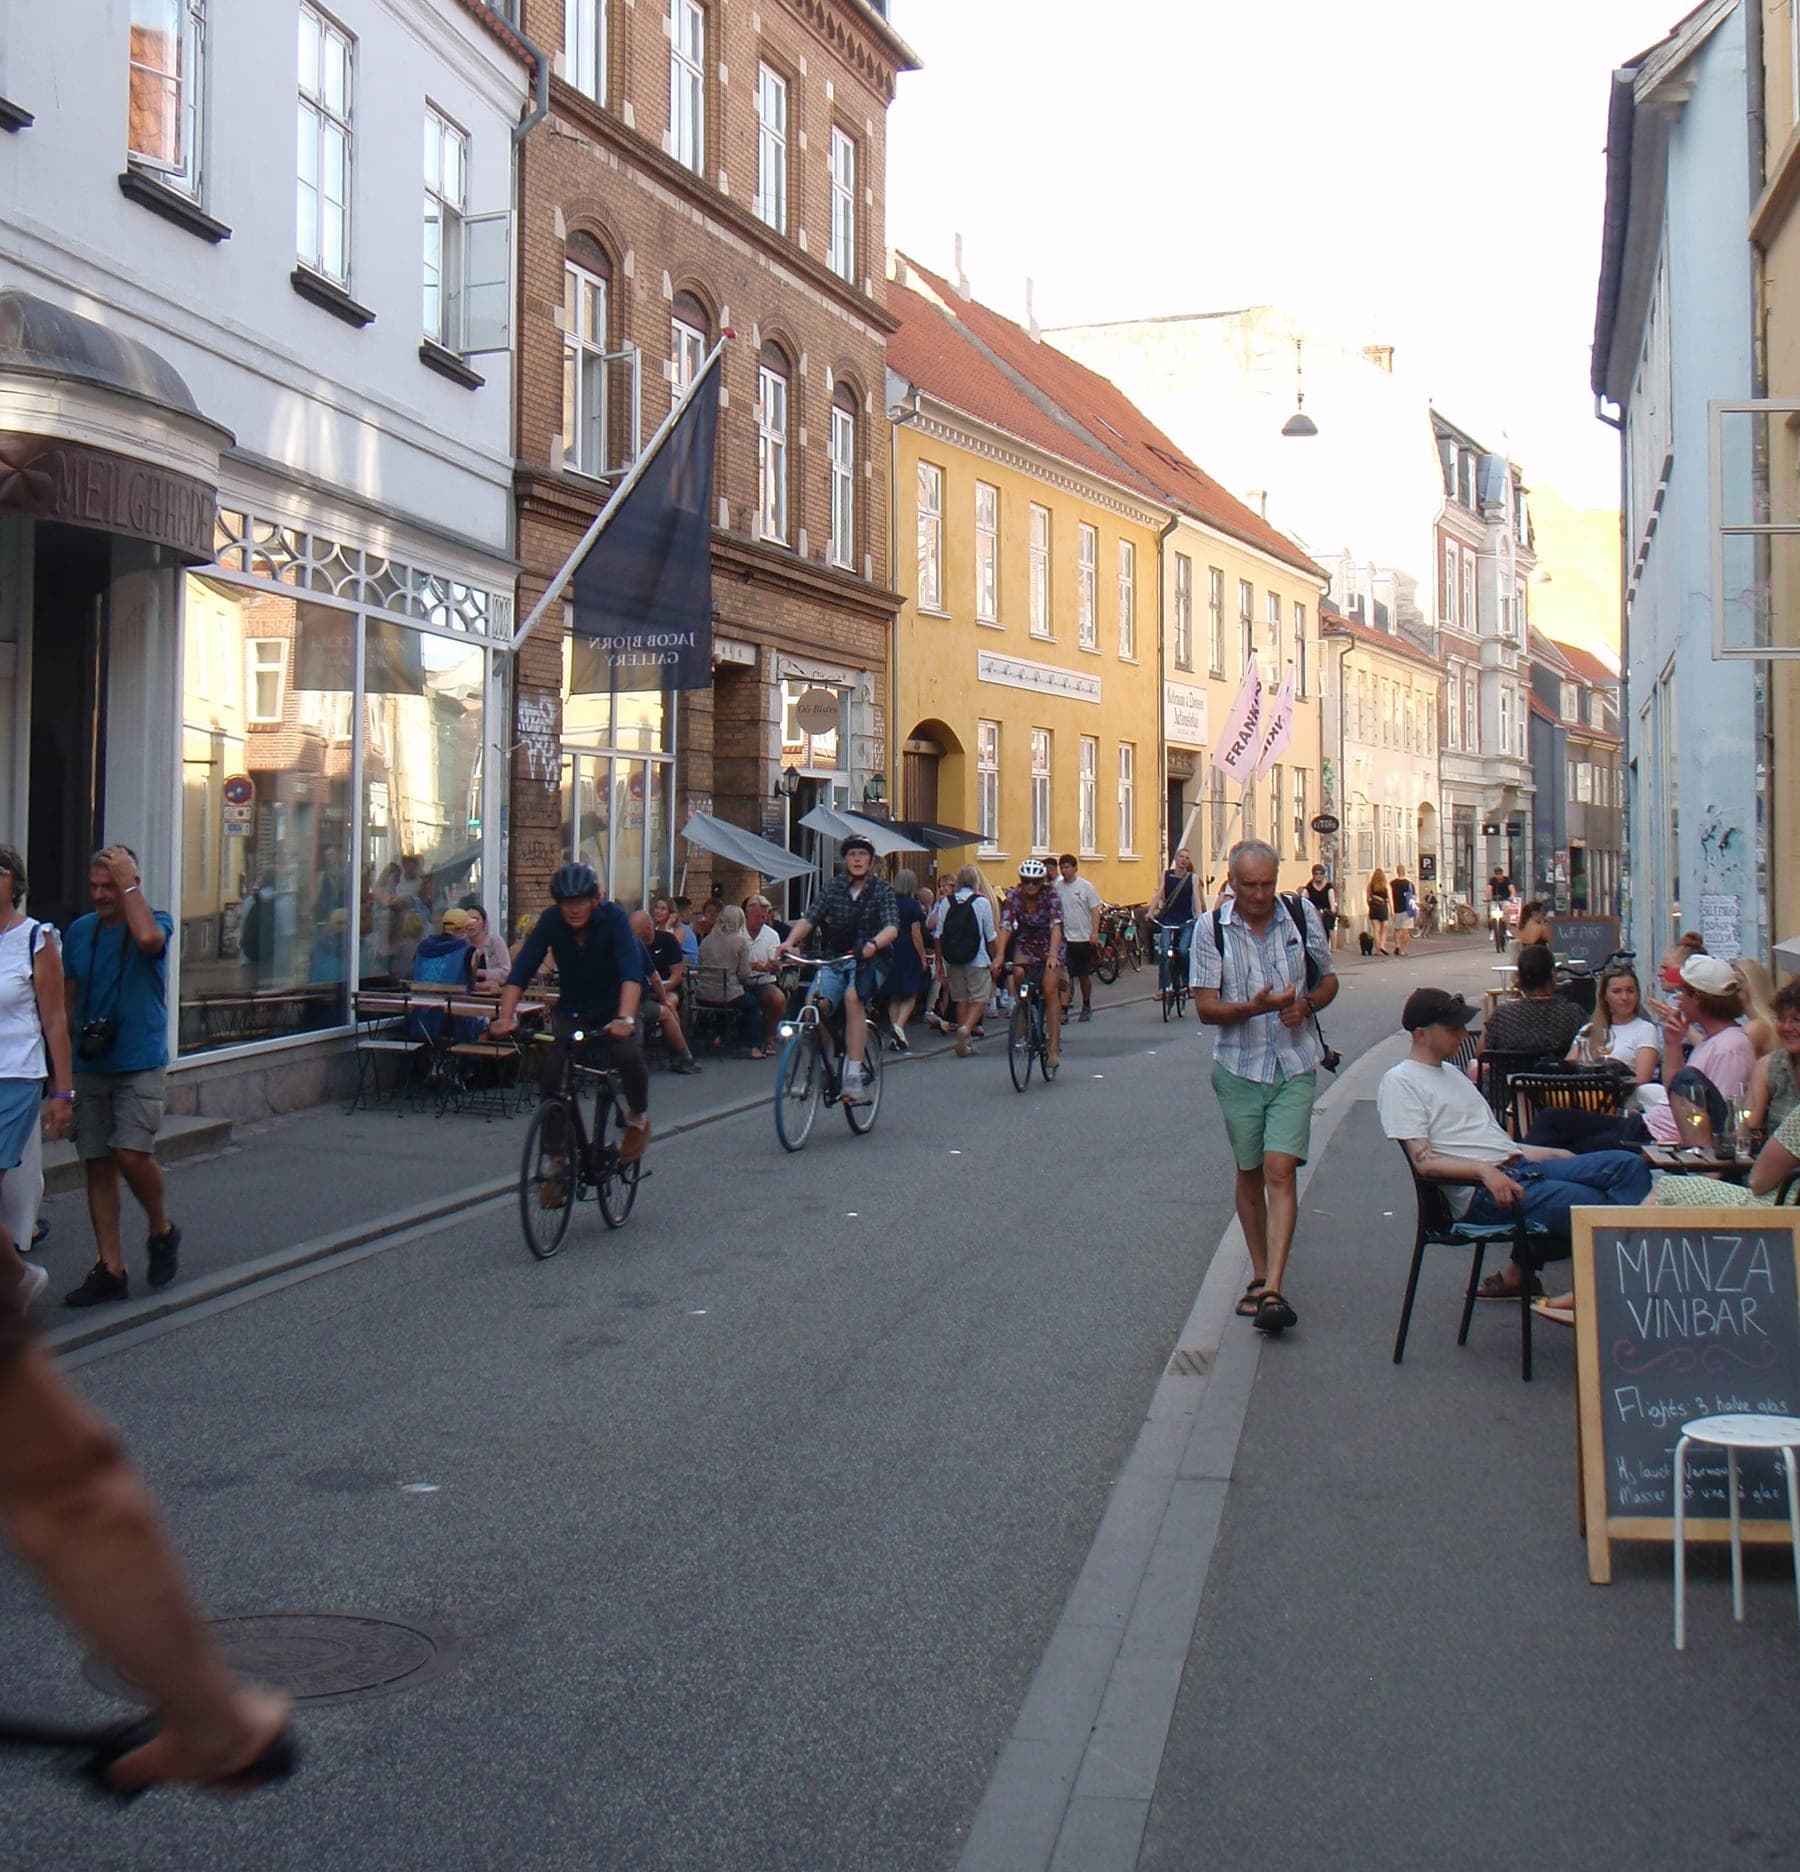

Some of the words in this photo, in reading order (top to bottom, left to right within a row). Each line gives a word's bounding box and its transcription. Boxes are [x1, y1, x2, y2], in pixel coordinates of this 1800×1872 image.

[1616, 1235, 1774, 1294] MANZA
[1627, 1297, 1768, 1340] VINBAR
[1695, 1396, 1709, 1415] 3
[1715, 1394, 1750, 1413] halve
